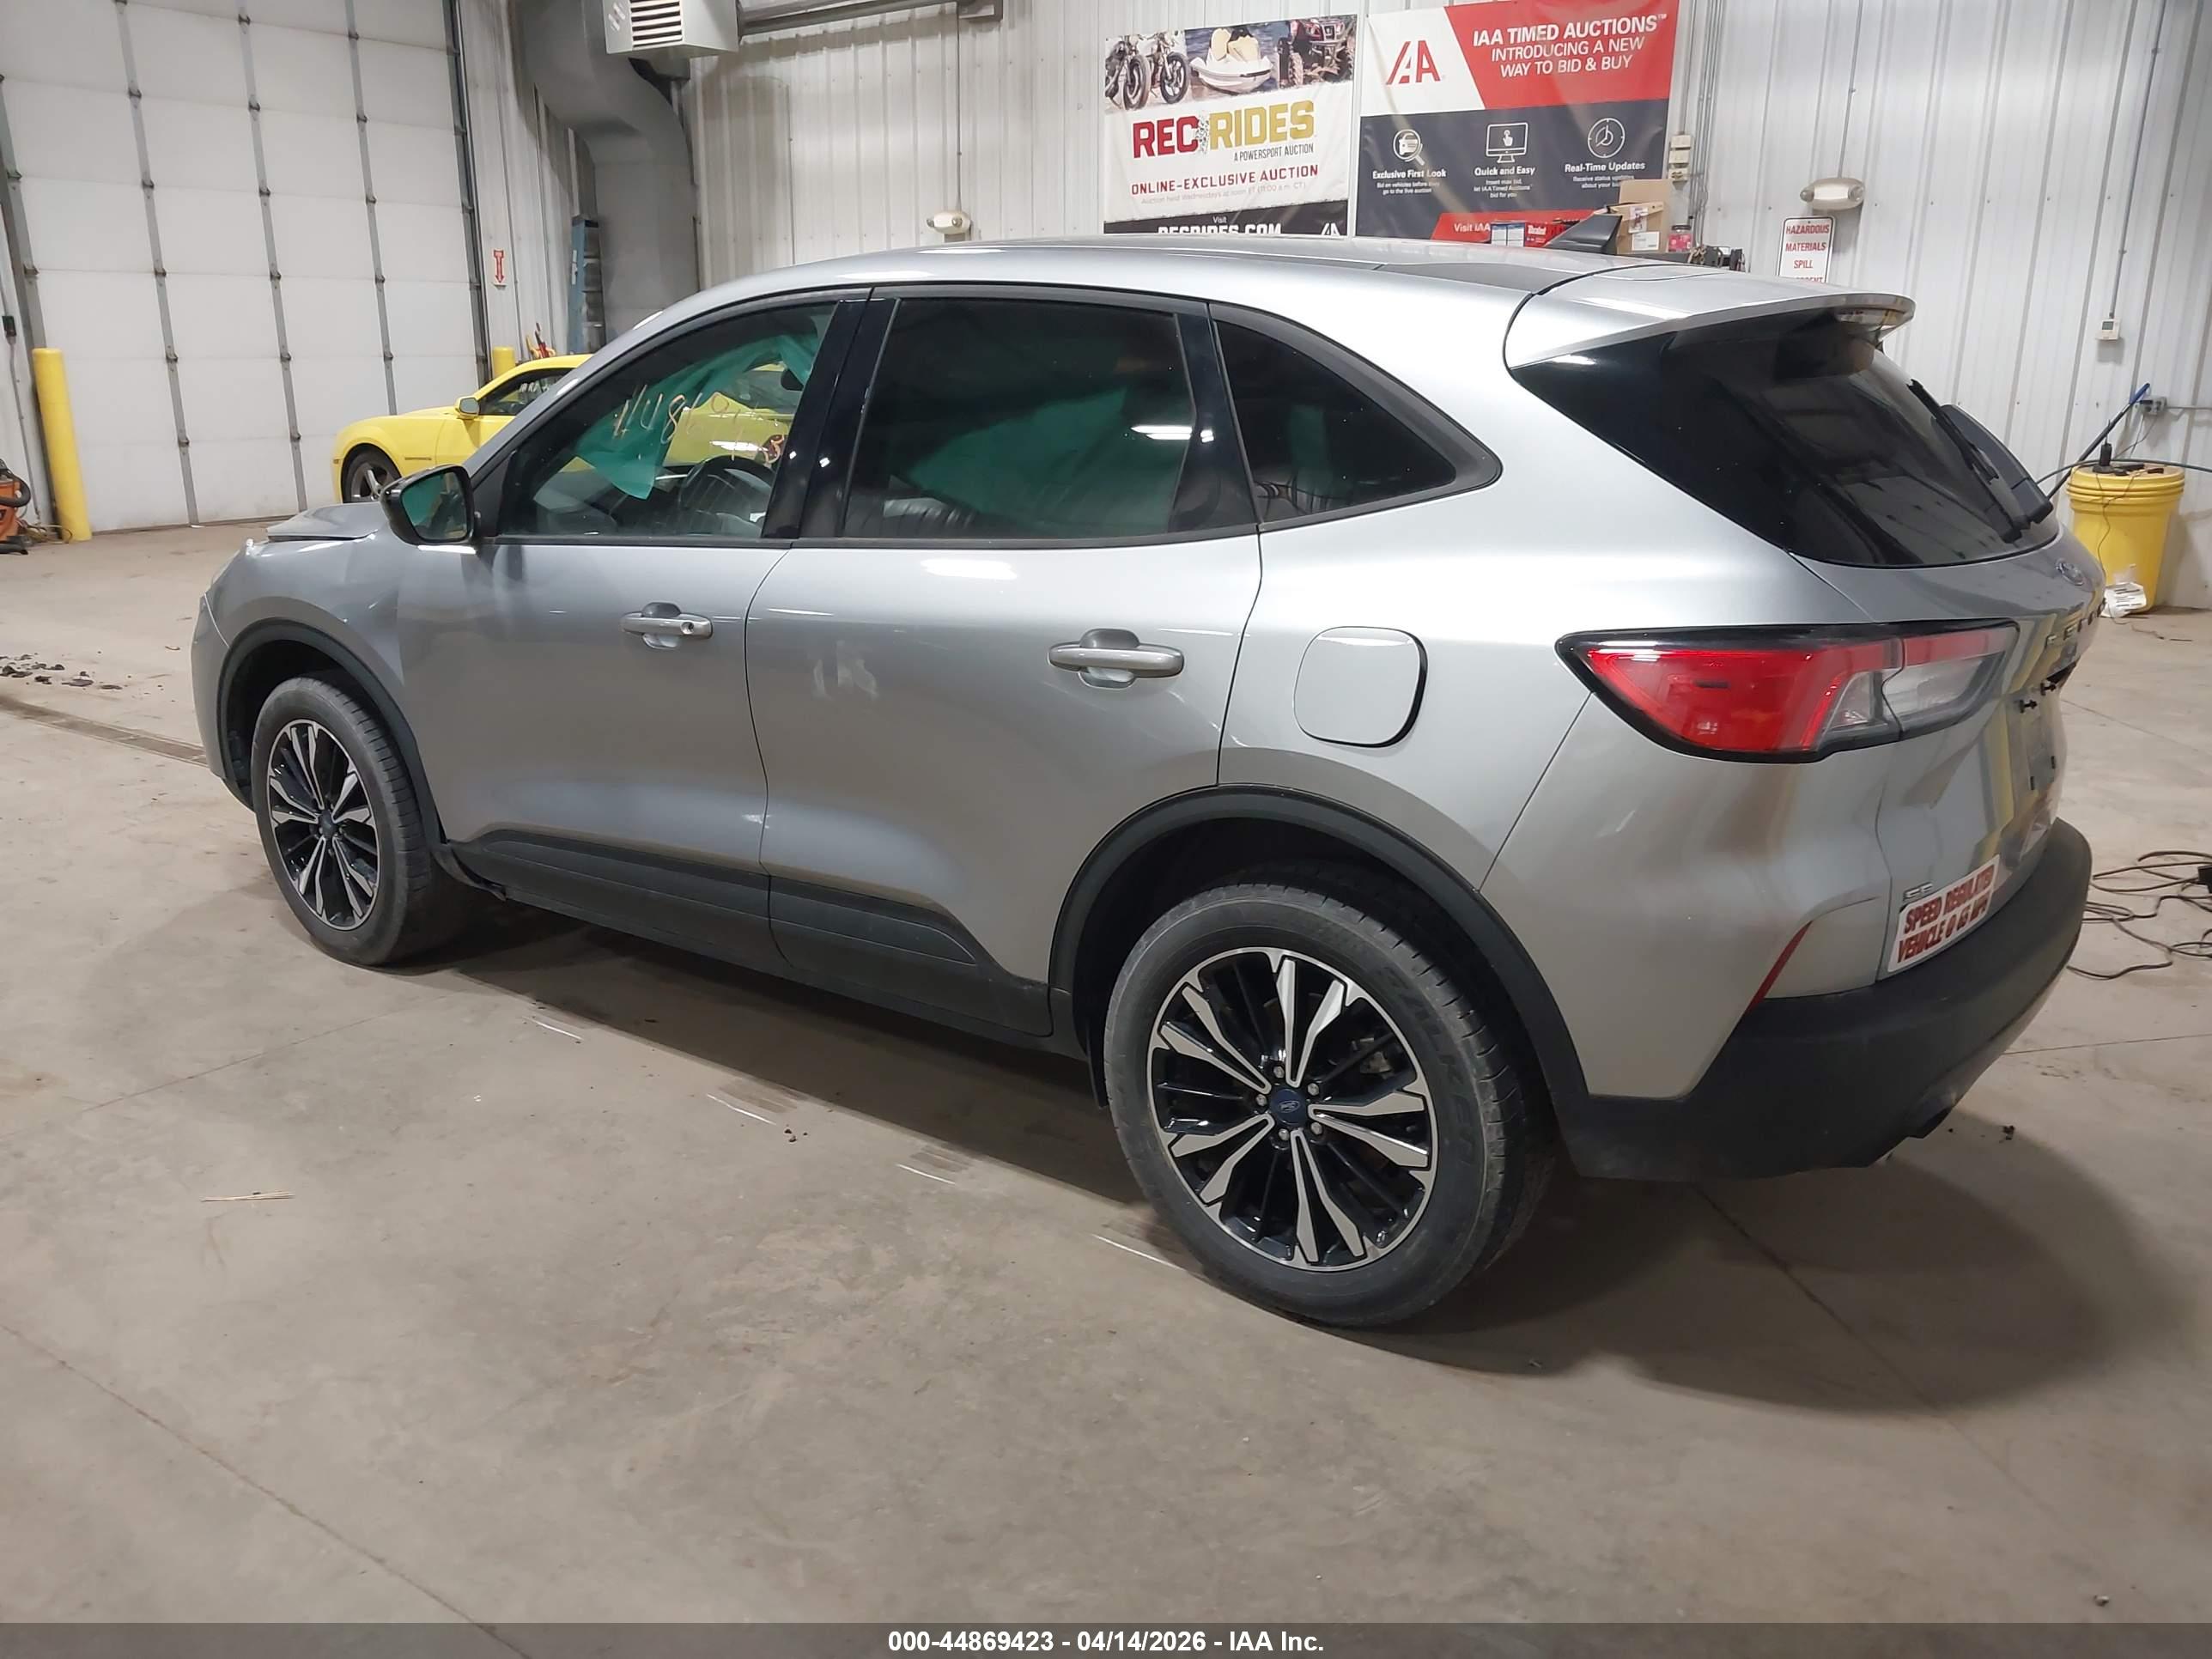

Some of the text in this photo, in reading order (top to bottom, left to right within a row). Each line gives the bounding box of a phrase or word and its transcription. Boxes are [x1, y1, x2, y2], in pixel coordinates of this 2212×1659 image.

[1473, 27, 1504, 46] IAA
[1507, 24, 1559, 43] TIMED
[1492, 36, 1645, 62] INTRODUCING A NEW
[1500, 55, 1633, 78] WAY TO BID & BUY
[1133, 100, 1314, 159] REC RIDES
[1234, 143, 1314, 161] A POWERSPORT AUCTION
[1372, 168, 1446, 179] Exclusive First Look
[1474, 166, 1535, 176] Quick and Easy
[1565, 161, 1645, 173] Real-Time Updates
[1132, 165, 1318, 195] ONLINE-EXCLUSIVE AUCTION
[1158, 222, 1282, 234] RECRIDESCOM
[1454, 223, 1472, 232] Visit
[1786, 224, 1830, 234] HAZARDOUS
[1785, 242, 1826, 252] MATERIALS
[1794, 259, 1814, 269] SPILL
[1904, 896, 1942, 934] SPEED
[1897, 920, 1945, 963] VEHICLE
